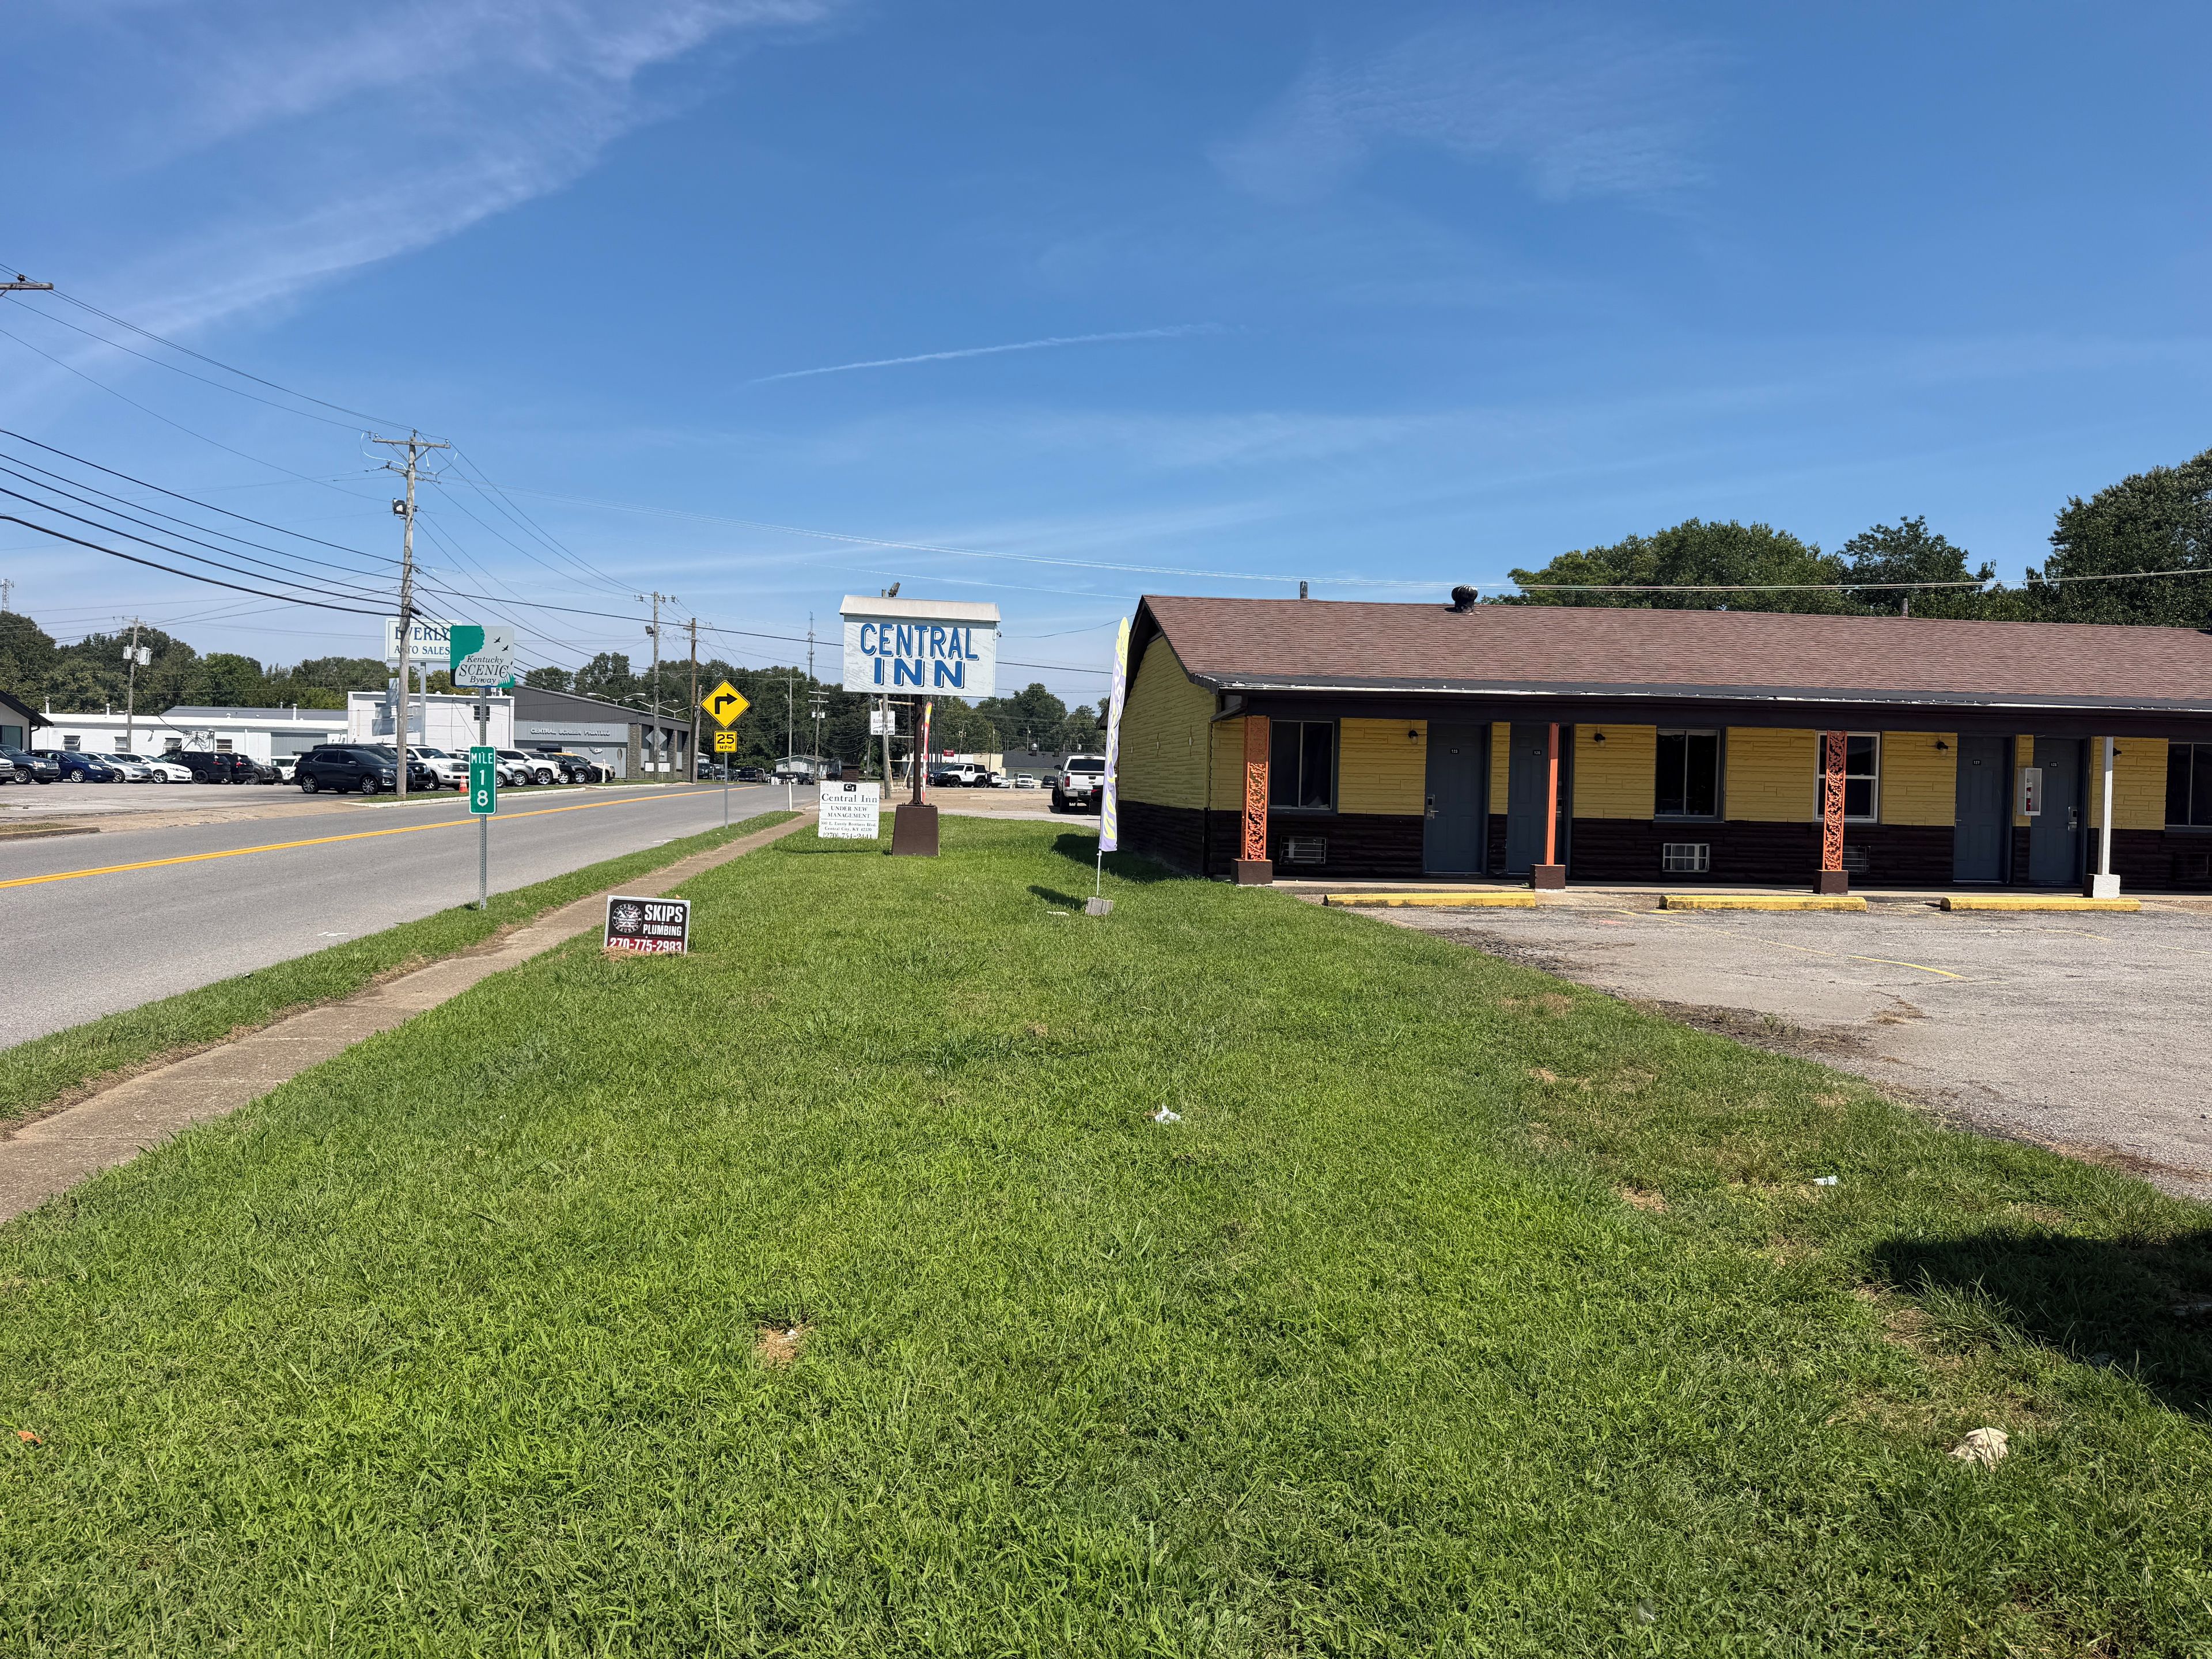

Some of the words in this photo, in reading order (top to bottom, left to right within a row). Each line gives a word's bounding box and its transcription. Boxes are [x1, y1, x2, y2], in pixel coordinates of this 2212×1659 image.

[860, 623, 979, 661] CENTRAL
[422, 646, 450, 655] SALES
[467, 655, 503, 664] Kentucky
[459, 664, 509, 678] SCENIC
[874, 657, 965, 689] INN
[470, 676, 496, 684] Byway
[717, 734, 734, 744] 25
[471, 752, 493, 764] MILE
[479, 770, 484, 785] 1
[477, 790, 488, 806] 8
[821, 793, 857, 802] Central
[644, 904, 684, 923] SKIPS
[643, 924, 682, 936] PLUMBING
[609, 937, 682, 952] 270-775-2983
